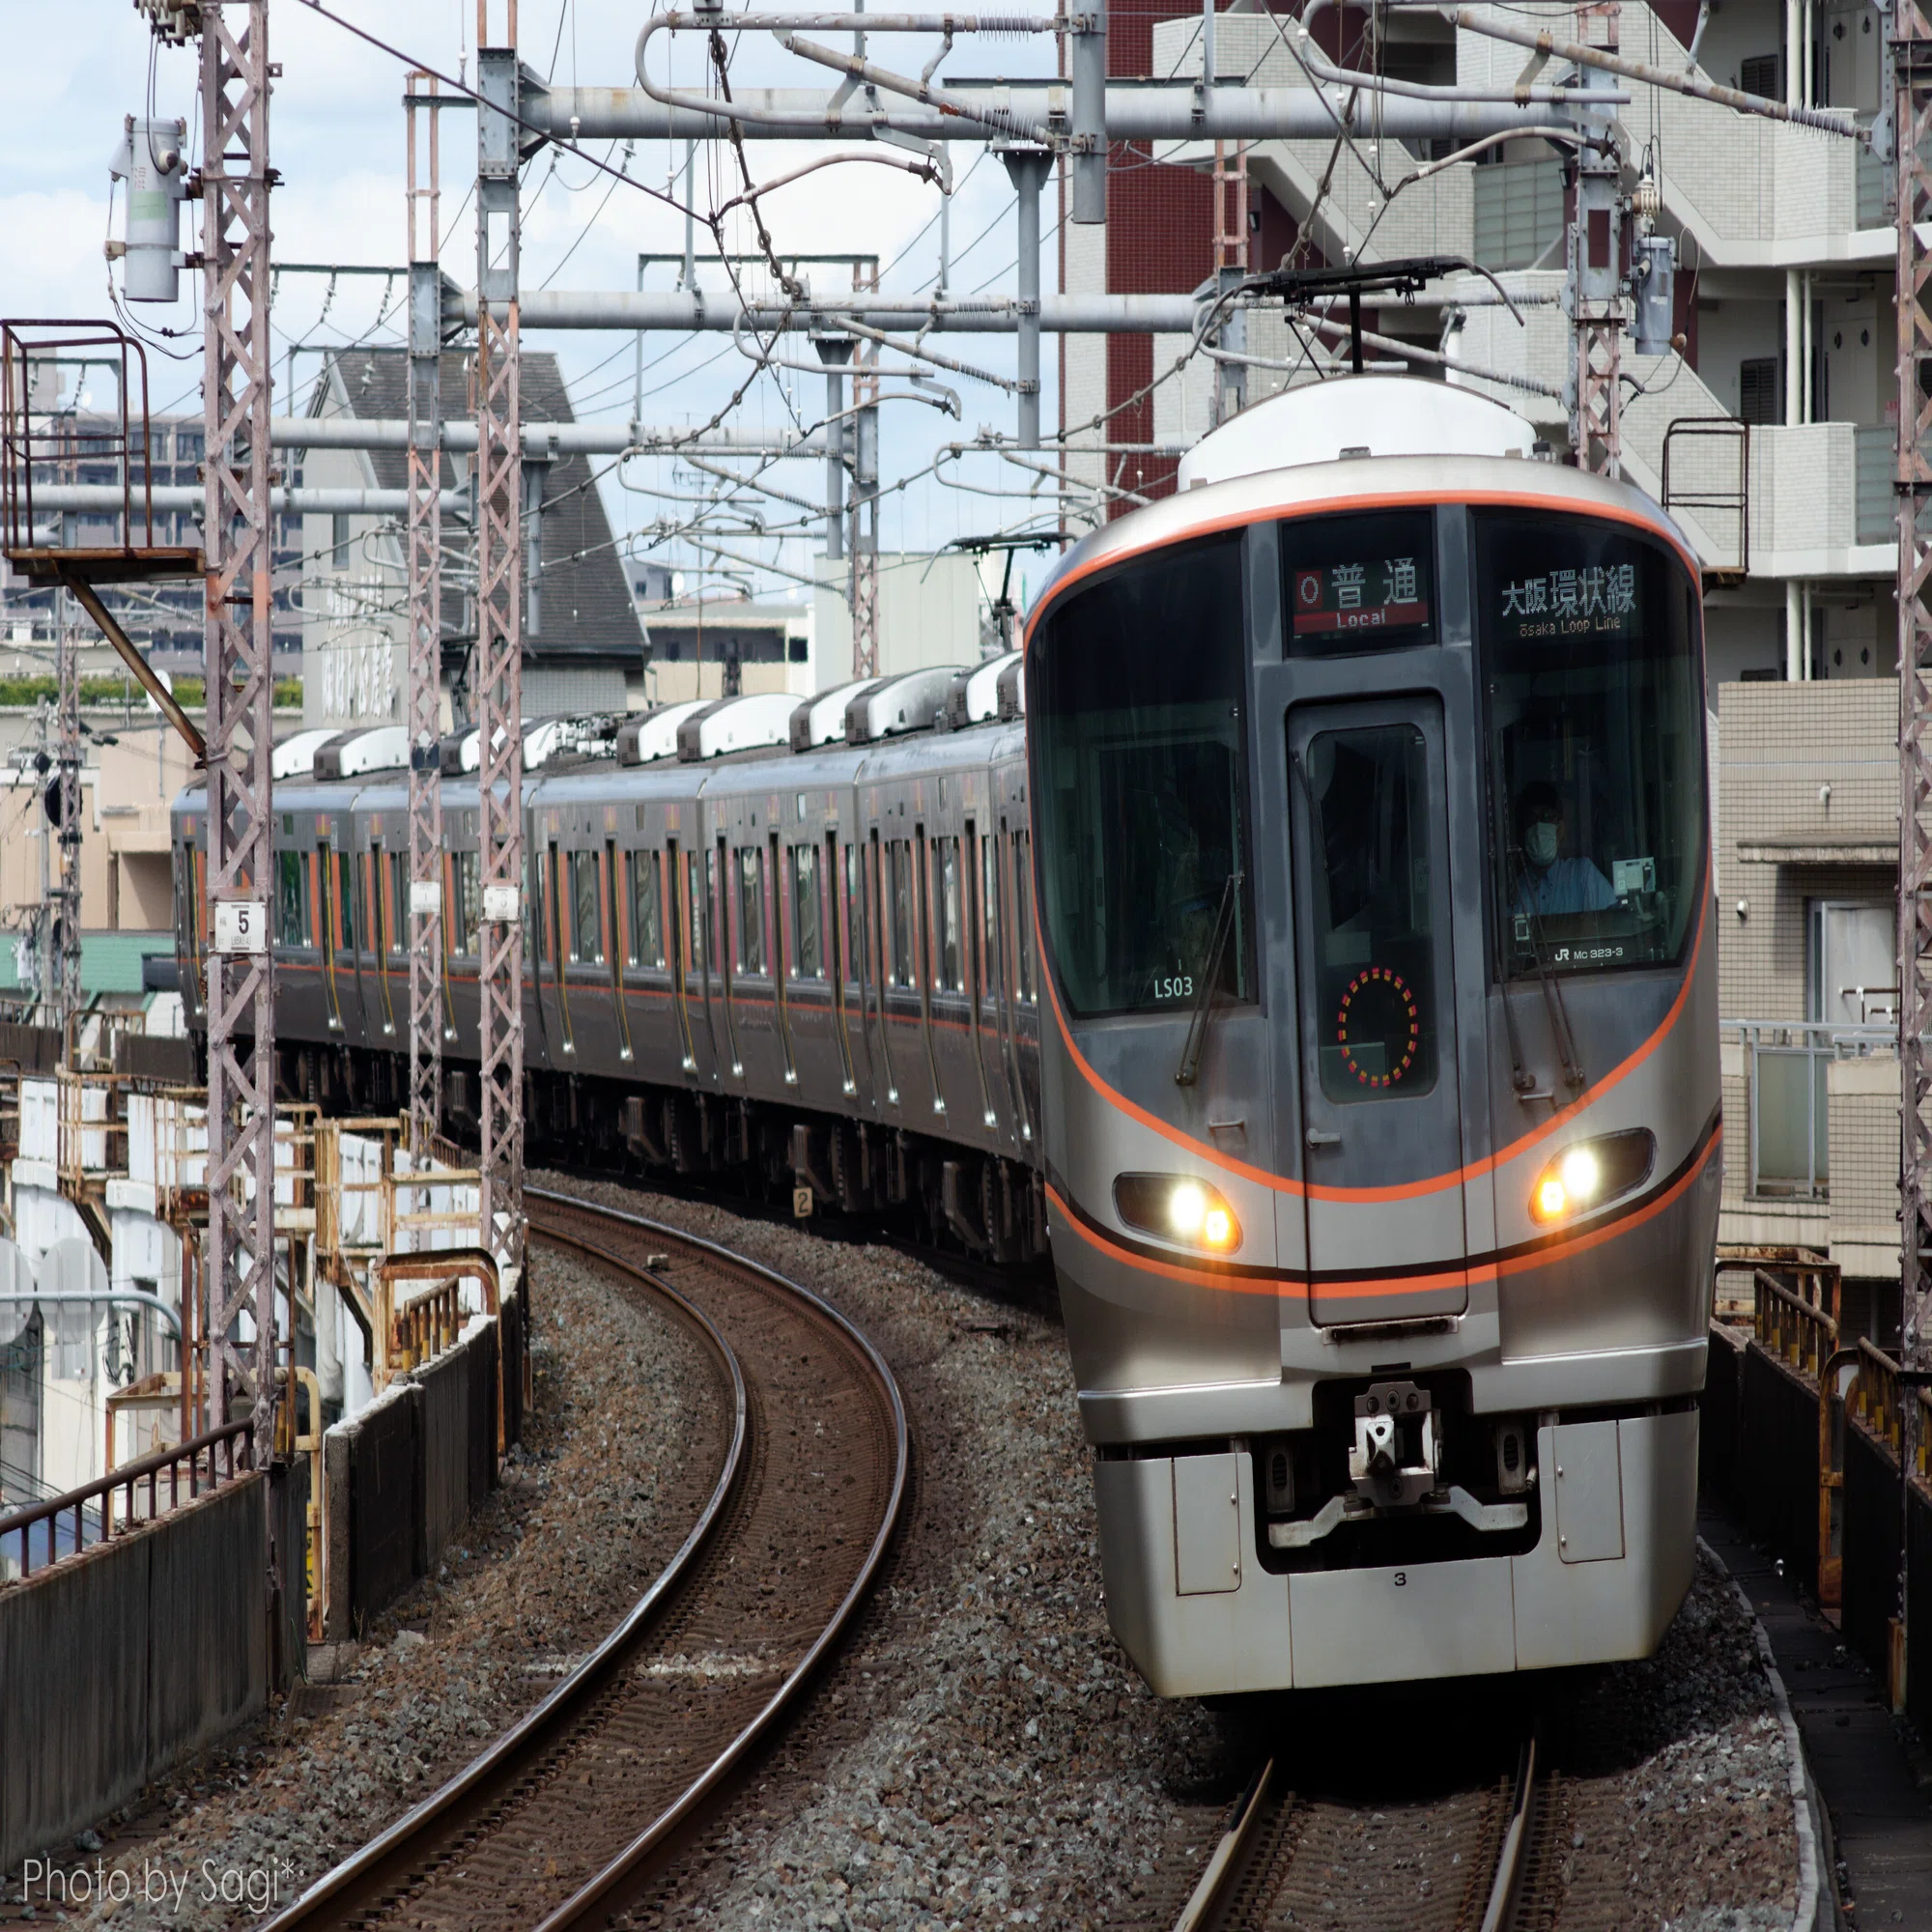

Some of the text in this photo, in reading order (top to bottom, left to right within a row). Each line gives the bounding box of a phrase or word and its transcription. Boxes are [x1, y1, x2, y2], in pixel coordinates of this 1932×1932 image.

[1332, 557, 1418, 609] 普通
[1501, 564, 1637, 618] 大阪環状線
[1336, 609, 1386, 629] Local
[1561, 618, 1591, 634] Loop
[1596, 615, 1621, 631] Line
[239, 910, 249, 934] 5
[1554, 948, 1624, 961] JR Mc 323-3
[1154, 977, 1193, 999] LS03
[798, 1191, 809, 1213] 2
[1394, 1572, 1406, 1587] 3
